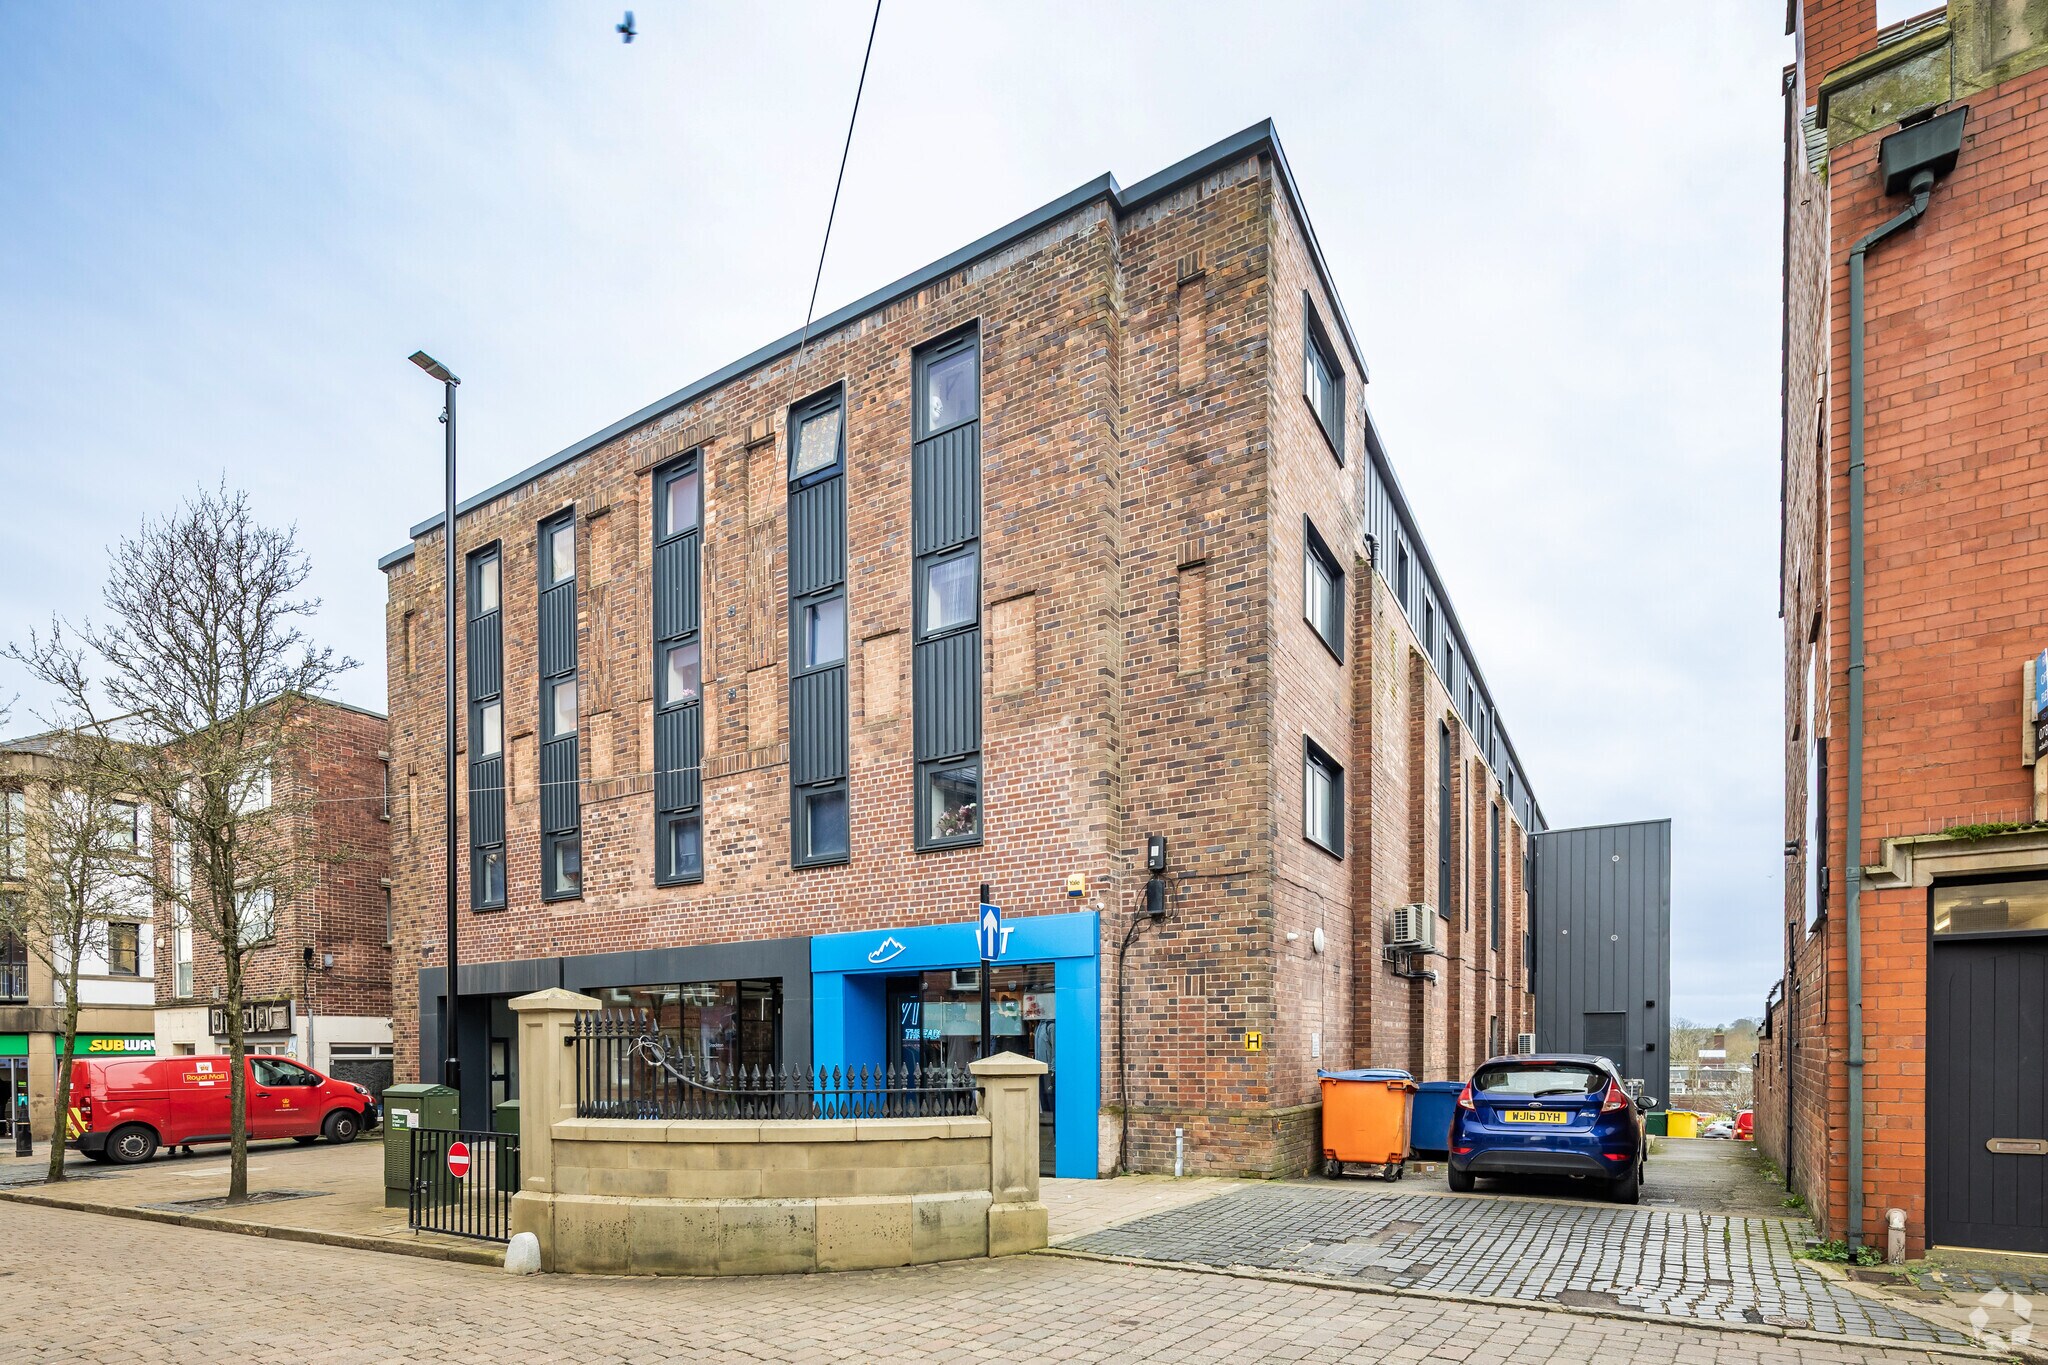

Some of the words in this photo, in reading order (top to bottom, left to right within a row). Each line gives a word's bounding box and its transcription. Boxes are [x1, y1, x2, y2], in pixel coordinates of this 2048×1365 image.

[1247, 1034, 1259, 1049] H
[186, 1074, 208, 1082] Royal
[1512, 1111, 1536, 1121] WJ16
[1539, 1112, 1561, 1122] DYH
